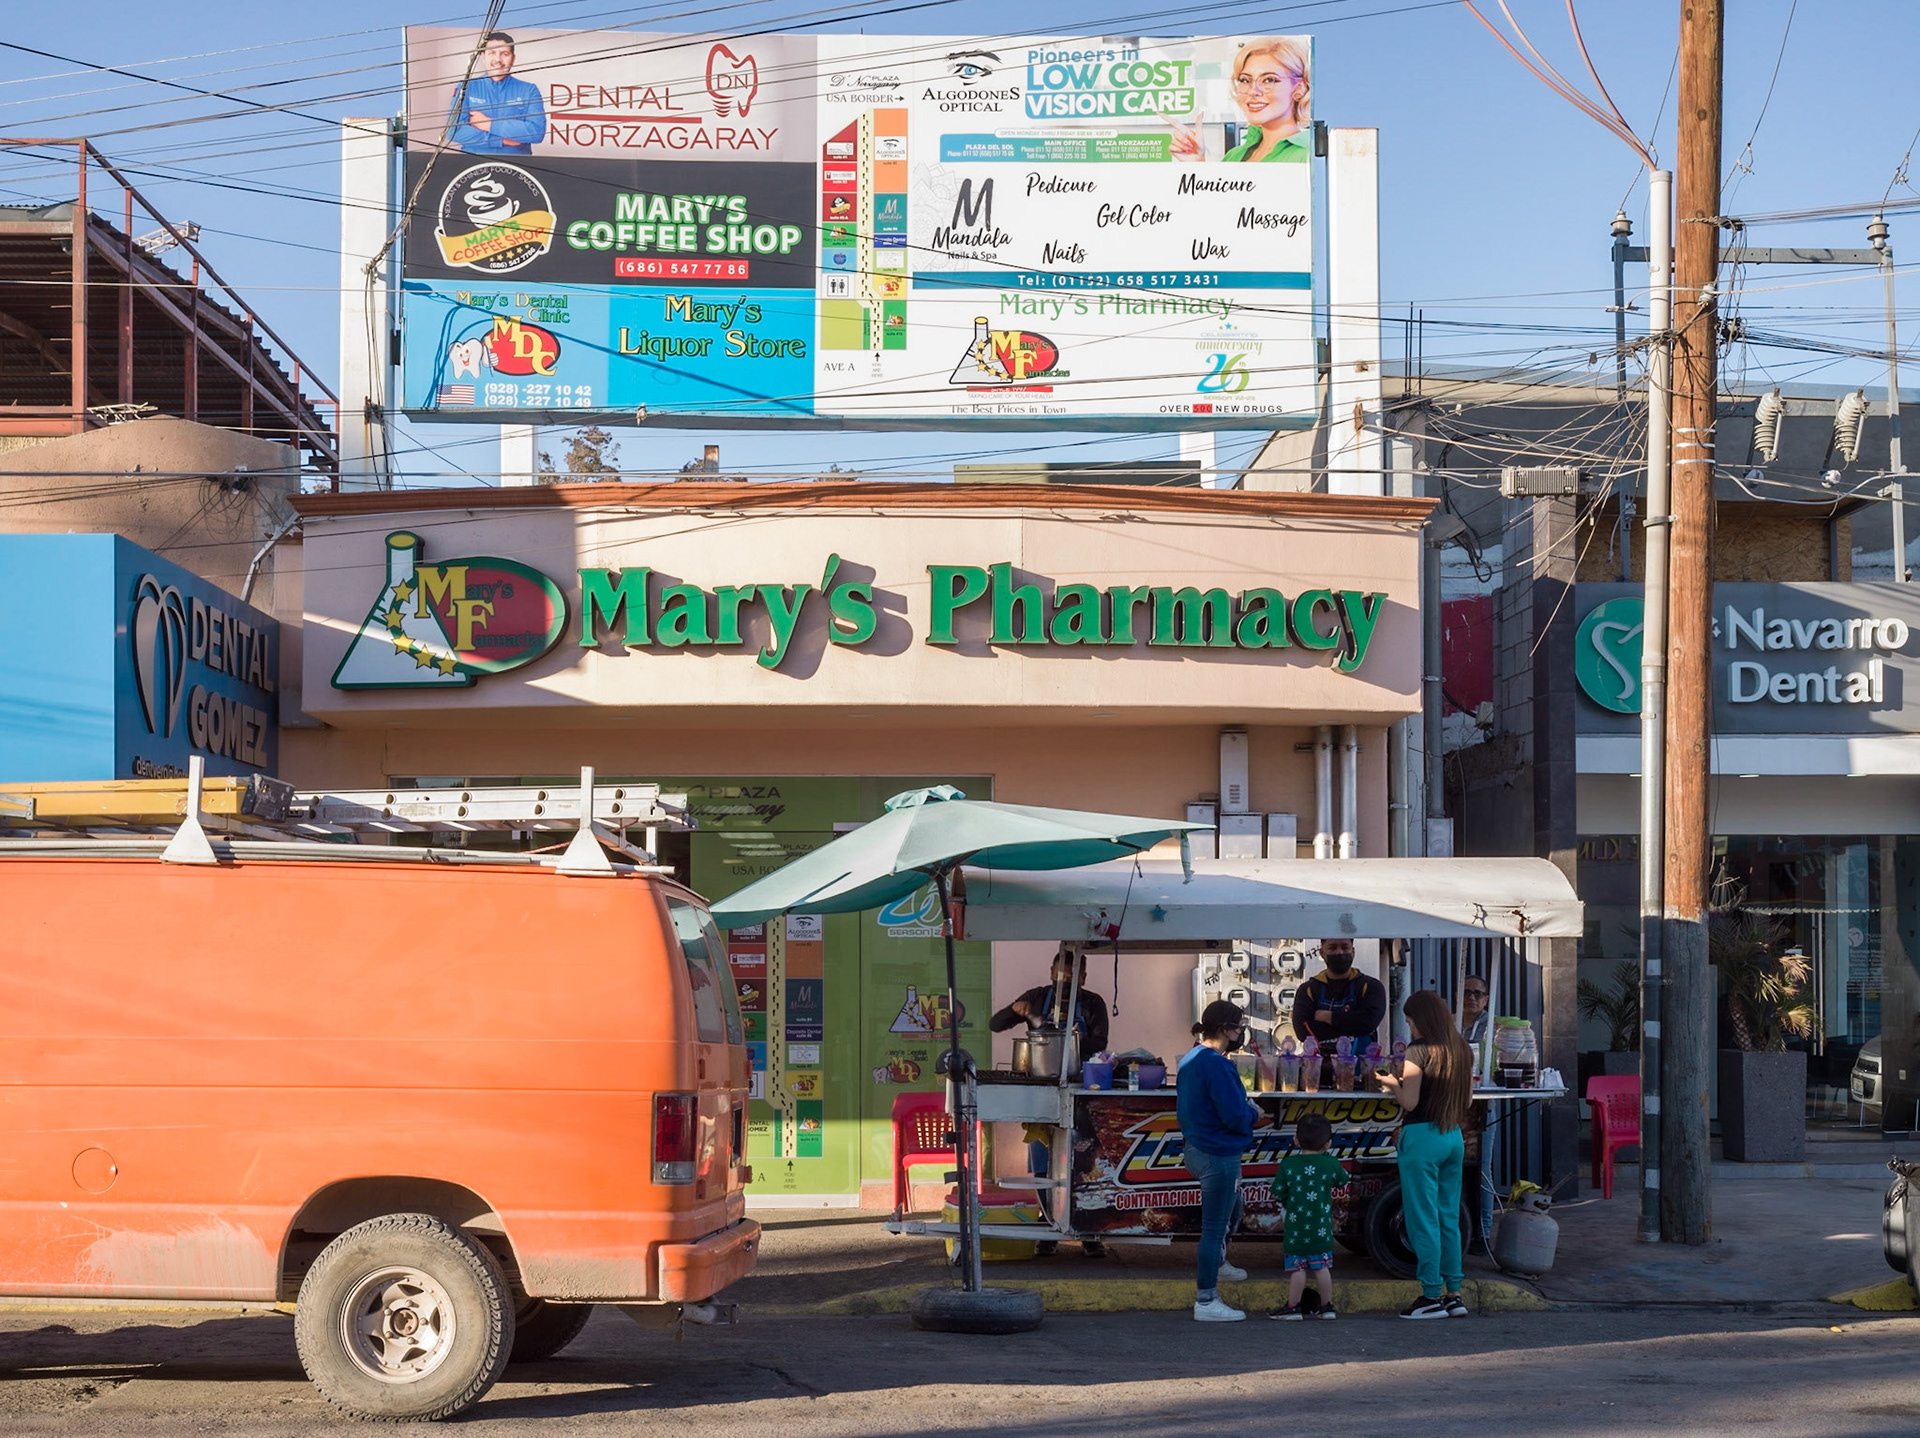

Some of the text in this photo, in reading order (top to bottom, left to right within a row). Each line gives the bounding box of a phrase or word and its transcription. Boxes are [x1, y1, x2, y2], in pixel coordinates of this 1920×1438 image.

[1027, 46, 1139, 64] Pioneers in
[716, 72, 749, 90] DN
[1027, 60, 1192, 92] LOW COST
[550, 83, 684, 111] DENTAL
[826, 94, 894, 103] USA BORDER
[922, 86, 1020, 102] ALGODONES
[1028, 89, 1192, 116] VISION CARE
[939, 101, 1003, 113] OPTICAL
[550, 122, 779, 150] NORZAGARAY
[490, 166, 512, 176] FOOD
[518, 173, 540, 196] SNACKS
[1026, 172, 1256, 197] Pedicure Manicure
[615, 193, 749, 224] MARY'S
[952, 178, 994, 232] M
[1097, 203, 1309, 238] Gel Color Massage
[453, 227, 545, 261] COFFEE SHOP
[464, 220, 521, 248] MARY'S
[566, 222, 802, 254] COFFEE SHOP
[932, 226, 1013, 250] Mandala
[980, 251, 997, 261] Spa
[1042, 238, 1230, 265] Nails Wax
[619, 261, 746, 276] (686) 547 77 86
[1017, 274, 1046, 286] Tel:
[1116, 274, 1144, 286] 658
[1150, 275, 1178, 286] 517
[1184, 275, 1220, 286] 3431
[456, 290, 568, 310] Mary's Dental
[665, 294, 762, 330] Mary's
[999, 294, 1235, 320] Mary's Pharmacy
[528, 307, 570, 323] Clinic
[619, 328, 806, 362] Liquor Store
[1195, 341, 1262, 355] anniversary
[848, 363, 855, 371] A
[484, 383, 518, 396] (928)
[555, 386, 572, 395] 10
[575, 386, 592, 396] 42
[484, 395, 518, 408] (928)
[555, 397, 572, 406] 10
[575, 397, 592, 407] 49
[951, 404, 1066, 414] The Best Prices in Town
[1159, 405, 1190, 413] OVER
[1193, 405, 1212, 413] 500
[1244, 405, 1283, 413] DRUGS
[577, 552, 1389, 674] Mary's Pharmacy
[1724, 604, 1910, 652] Navarro
[188, 596, 275, 693] DENTAL
[1727, 657, 1884, 704] Dental
[187, 684, 268, 768] GOMEZ
[708, 786, 782, 799] PLAZA
[732, 866, 756, 876] USA
[1305, 945, 1321, 960] 47
[1283, 1098, 1400, 1123] TACOS
[758, 1173, 766, 1182] A
[1116, 1189, 1202, 1210] CONTRATACIONE
